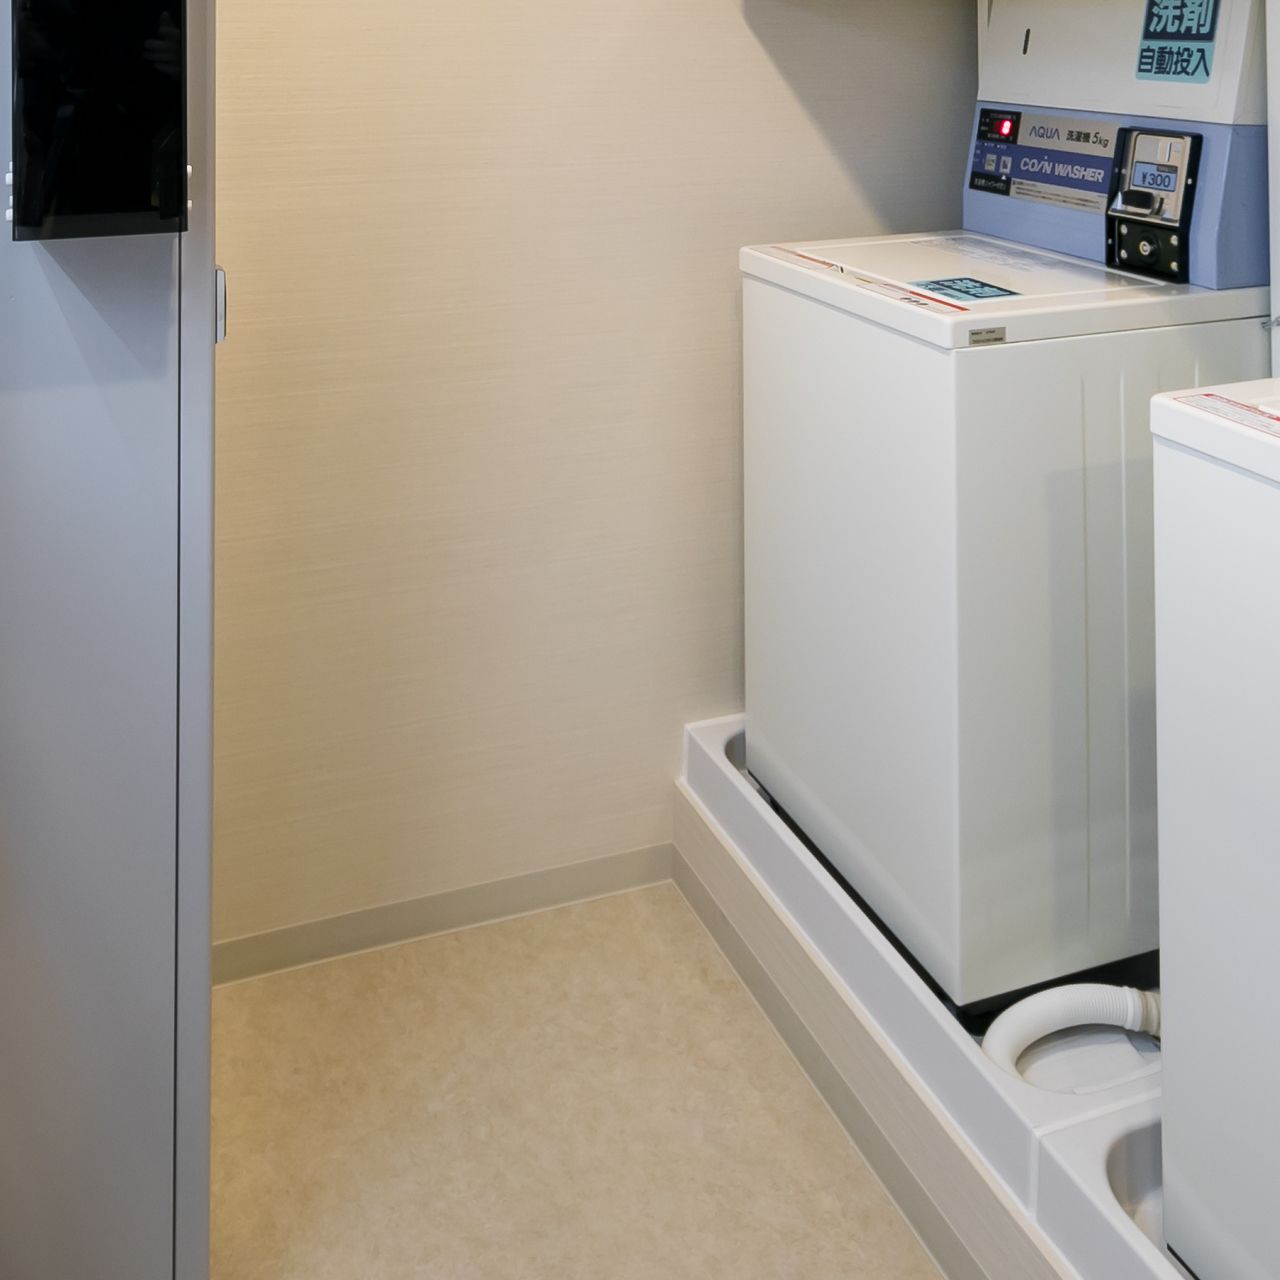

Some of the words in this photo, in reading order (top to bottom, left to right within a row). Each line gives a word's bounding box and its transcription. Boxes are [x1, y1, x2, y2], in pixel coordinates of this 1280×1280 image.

[1137, 46, 1210, 79] 自動投入
[1029, 125, 1061, 142] AQUA
[1066, 129, 1091, 144] 洗濯機
[1091, 131, 1110, 149] 5kg
[1054, 162, 1105, 183] WASHER
[1141, 171, 1171, 188] ¥300
